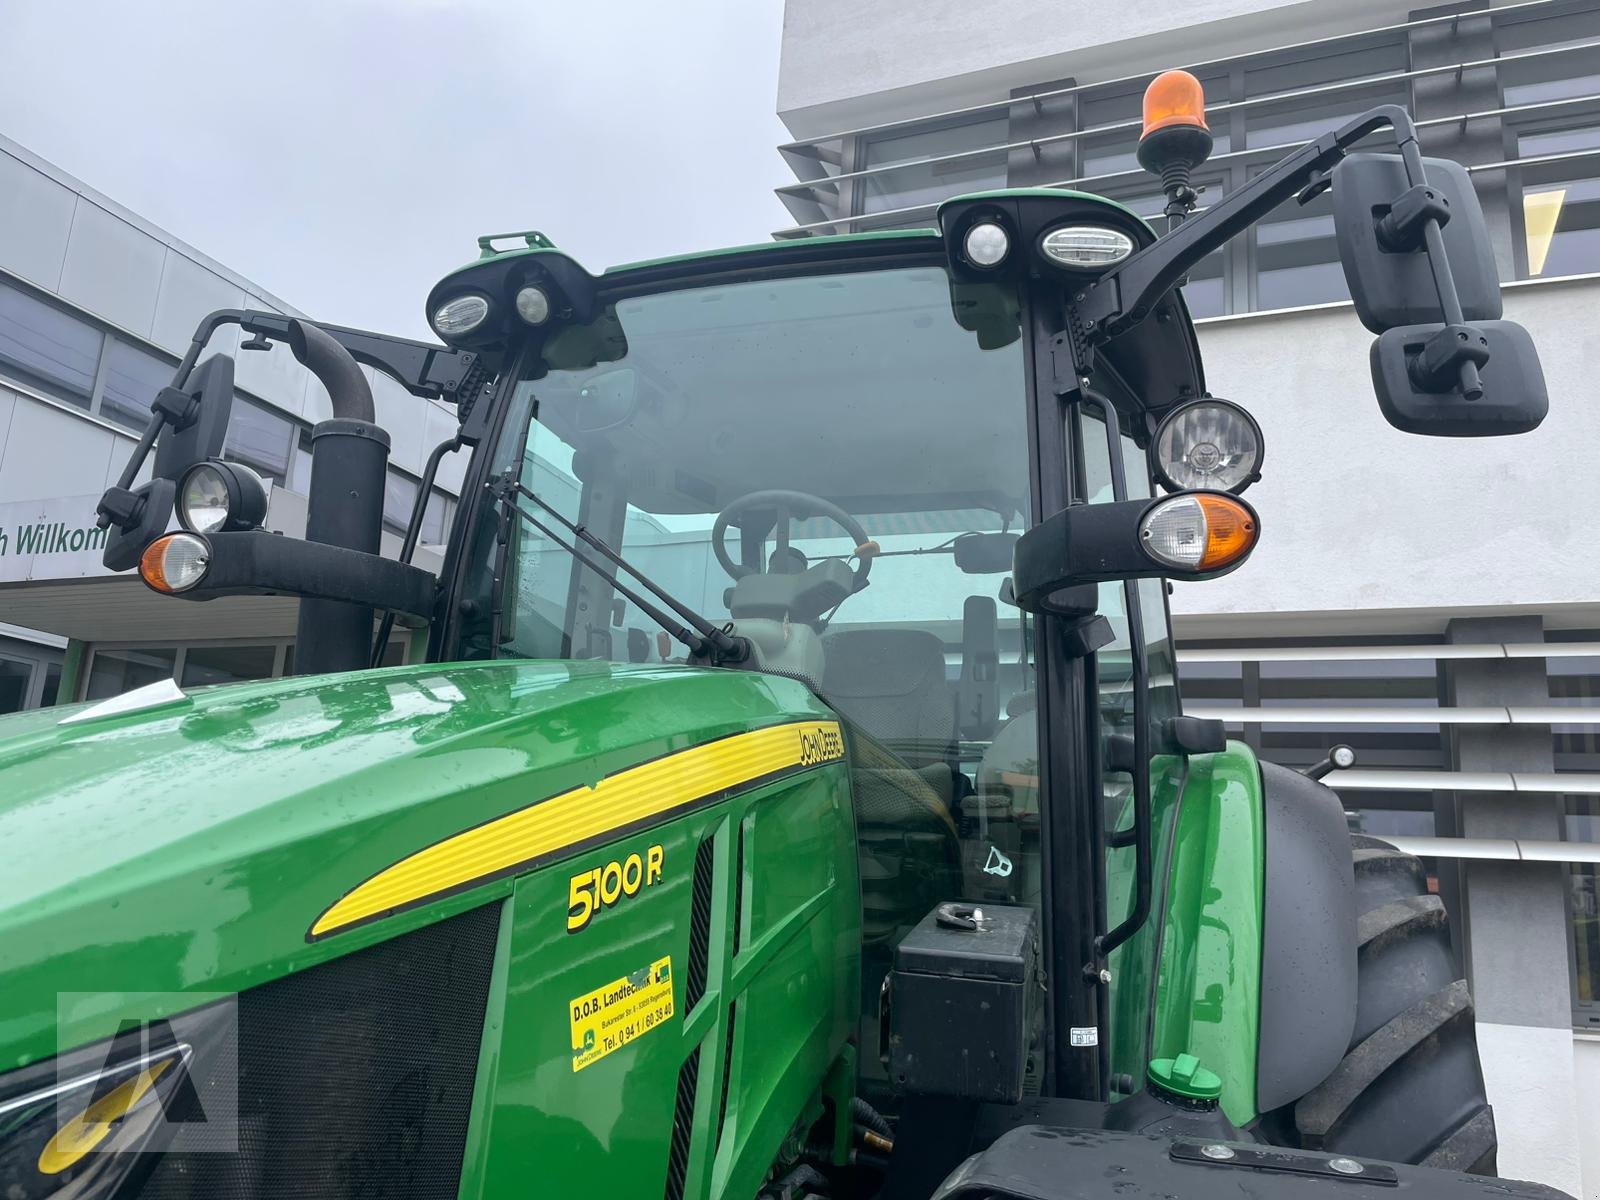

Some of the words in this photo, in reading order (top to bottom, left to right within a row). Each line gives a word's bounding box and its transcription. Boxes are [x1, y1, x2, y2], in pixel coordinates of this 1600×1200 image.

[567, 853, 643, 934] 5100
[647, 844, 664, 886] R
[574, 997, 602, 1022] D.O.B.
[604, 975, 651, 1008] Landtecik
[603, 1033, 617, 1051] Tel.
[626, 1023, 635, 1039] 94
